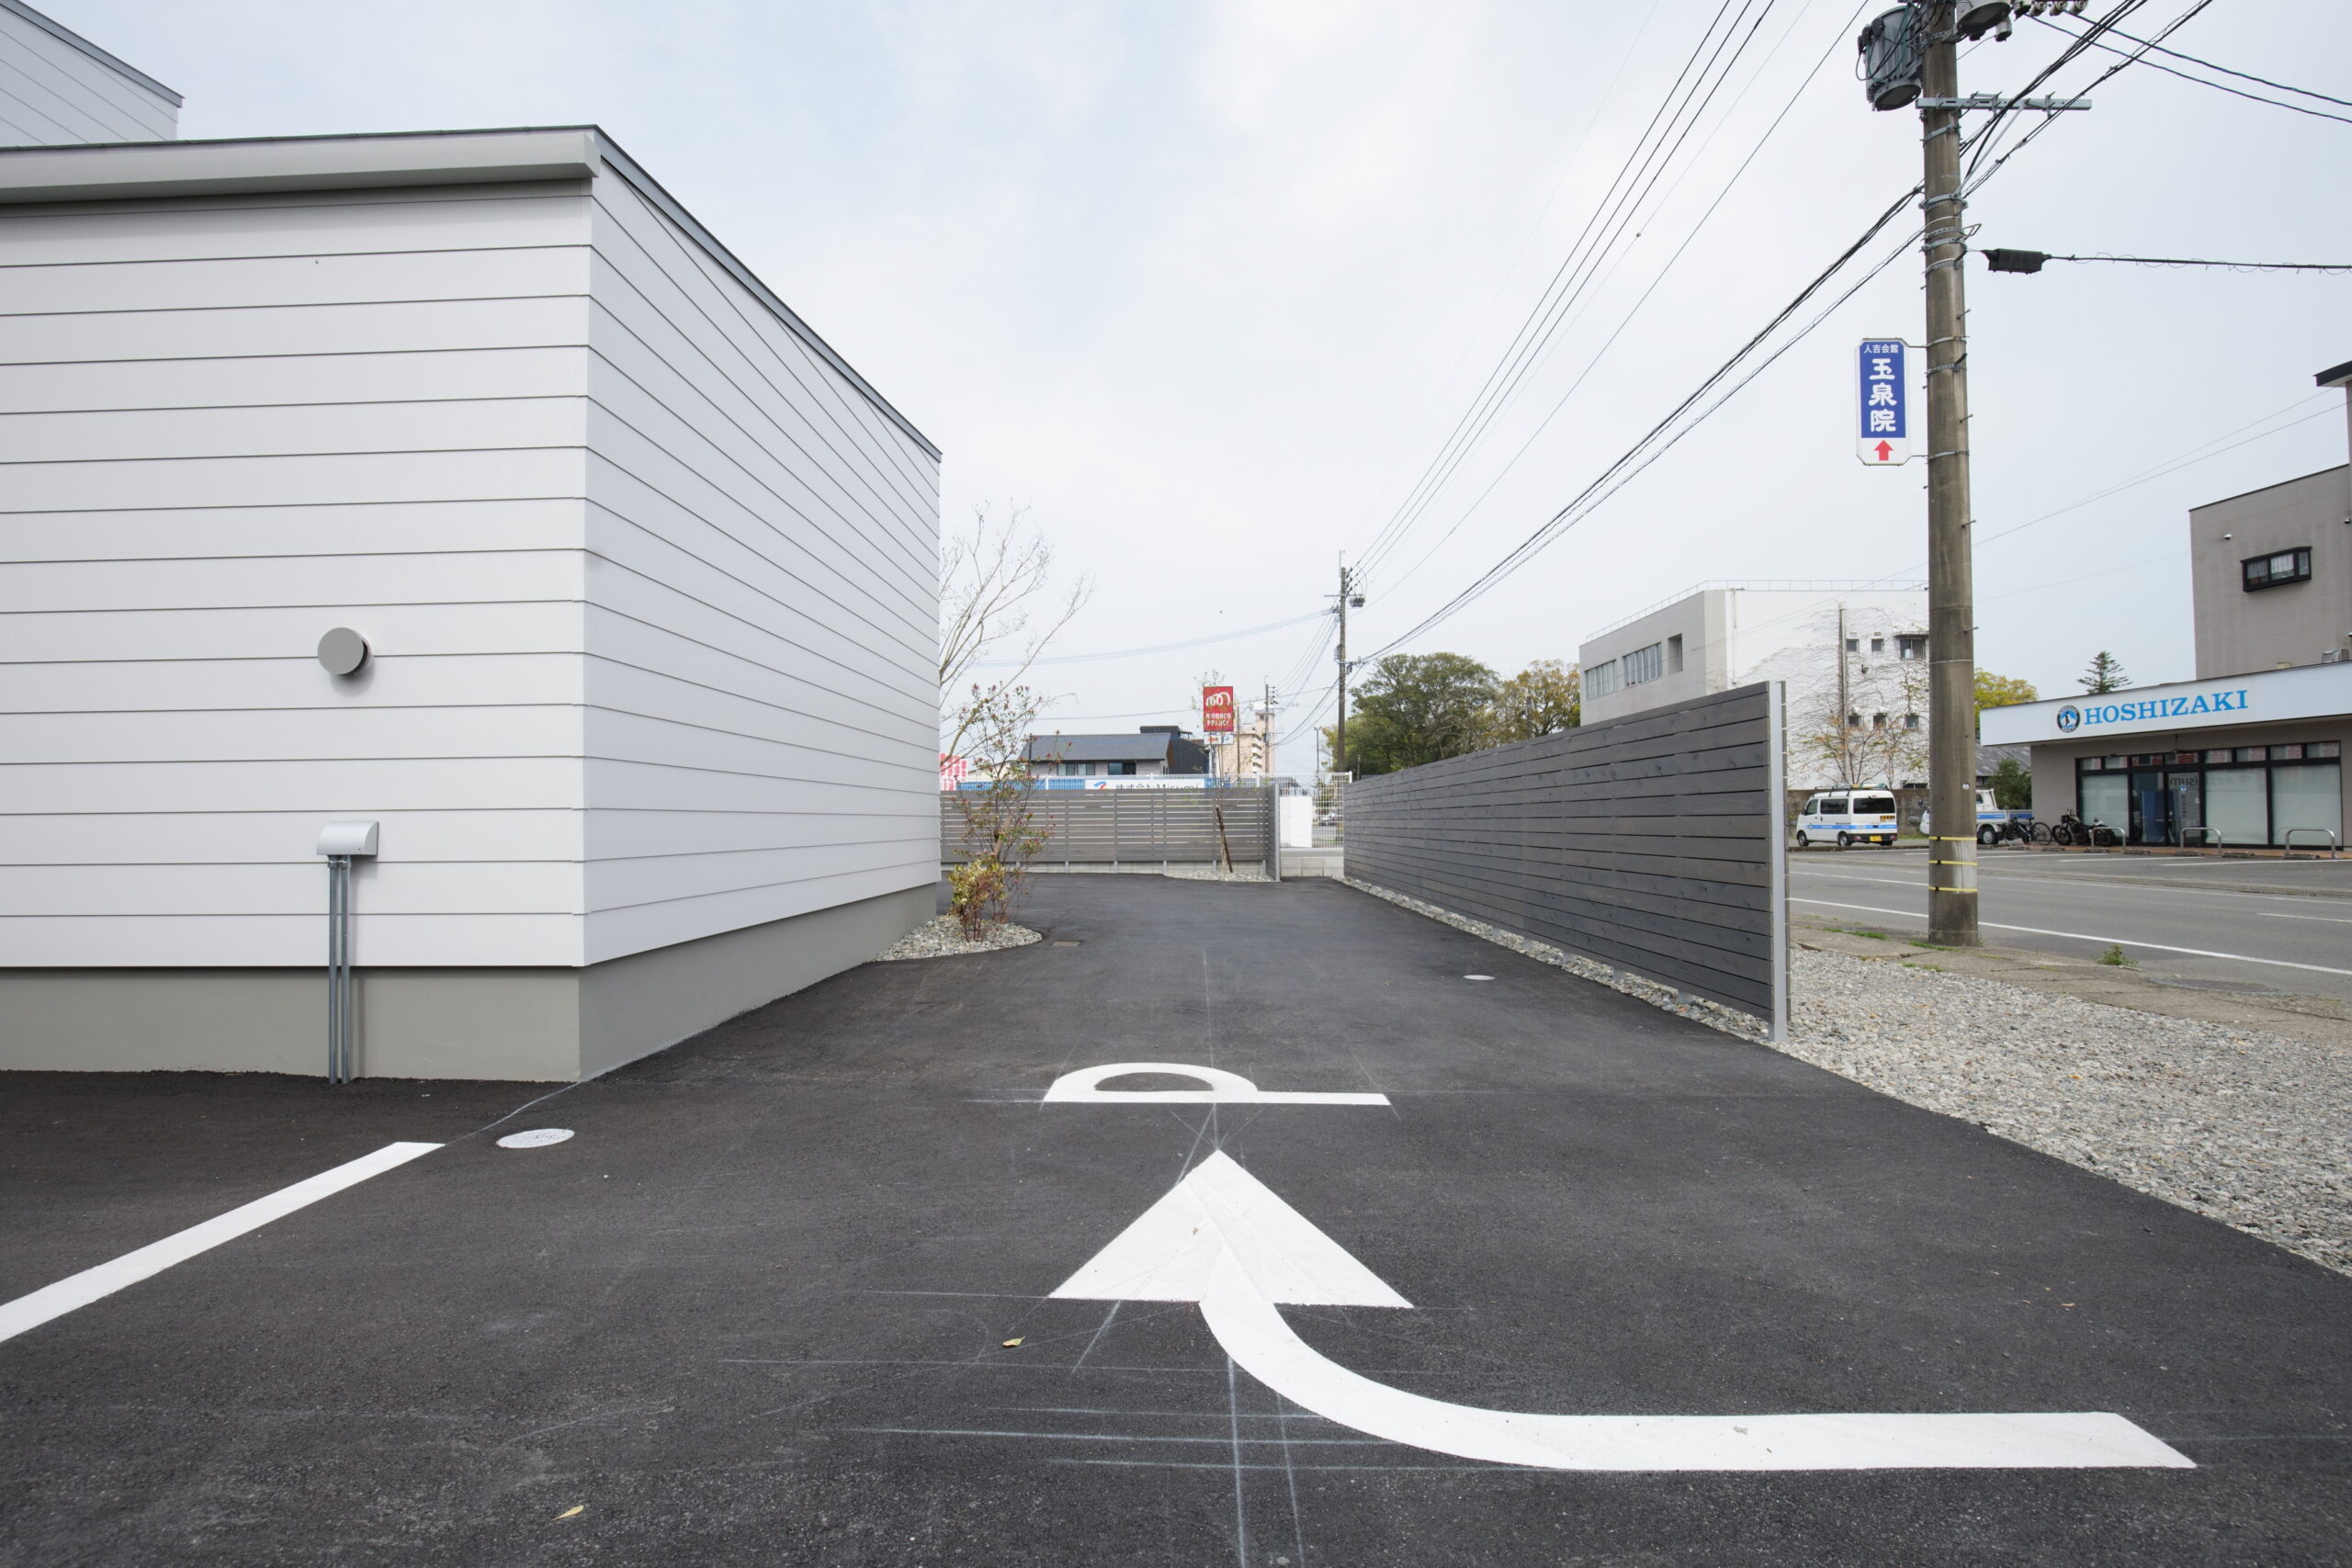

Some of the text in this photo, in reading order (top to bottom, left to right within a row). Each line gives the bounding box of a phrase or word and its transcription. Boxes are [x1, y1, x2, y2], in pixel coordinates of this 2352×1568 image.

[1863, 344, 1899, 354] 人吉会館
[1868, 358, 1897, 432] 玉泉院
[2084, 690, 2248, 725] HOSHIZAKI
